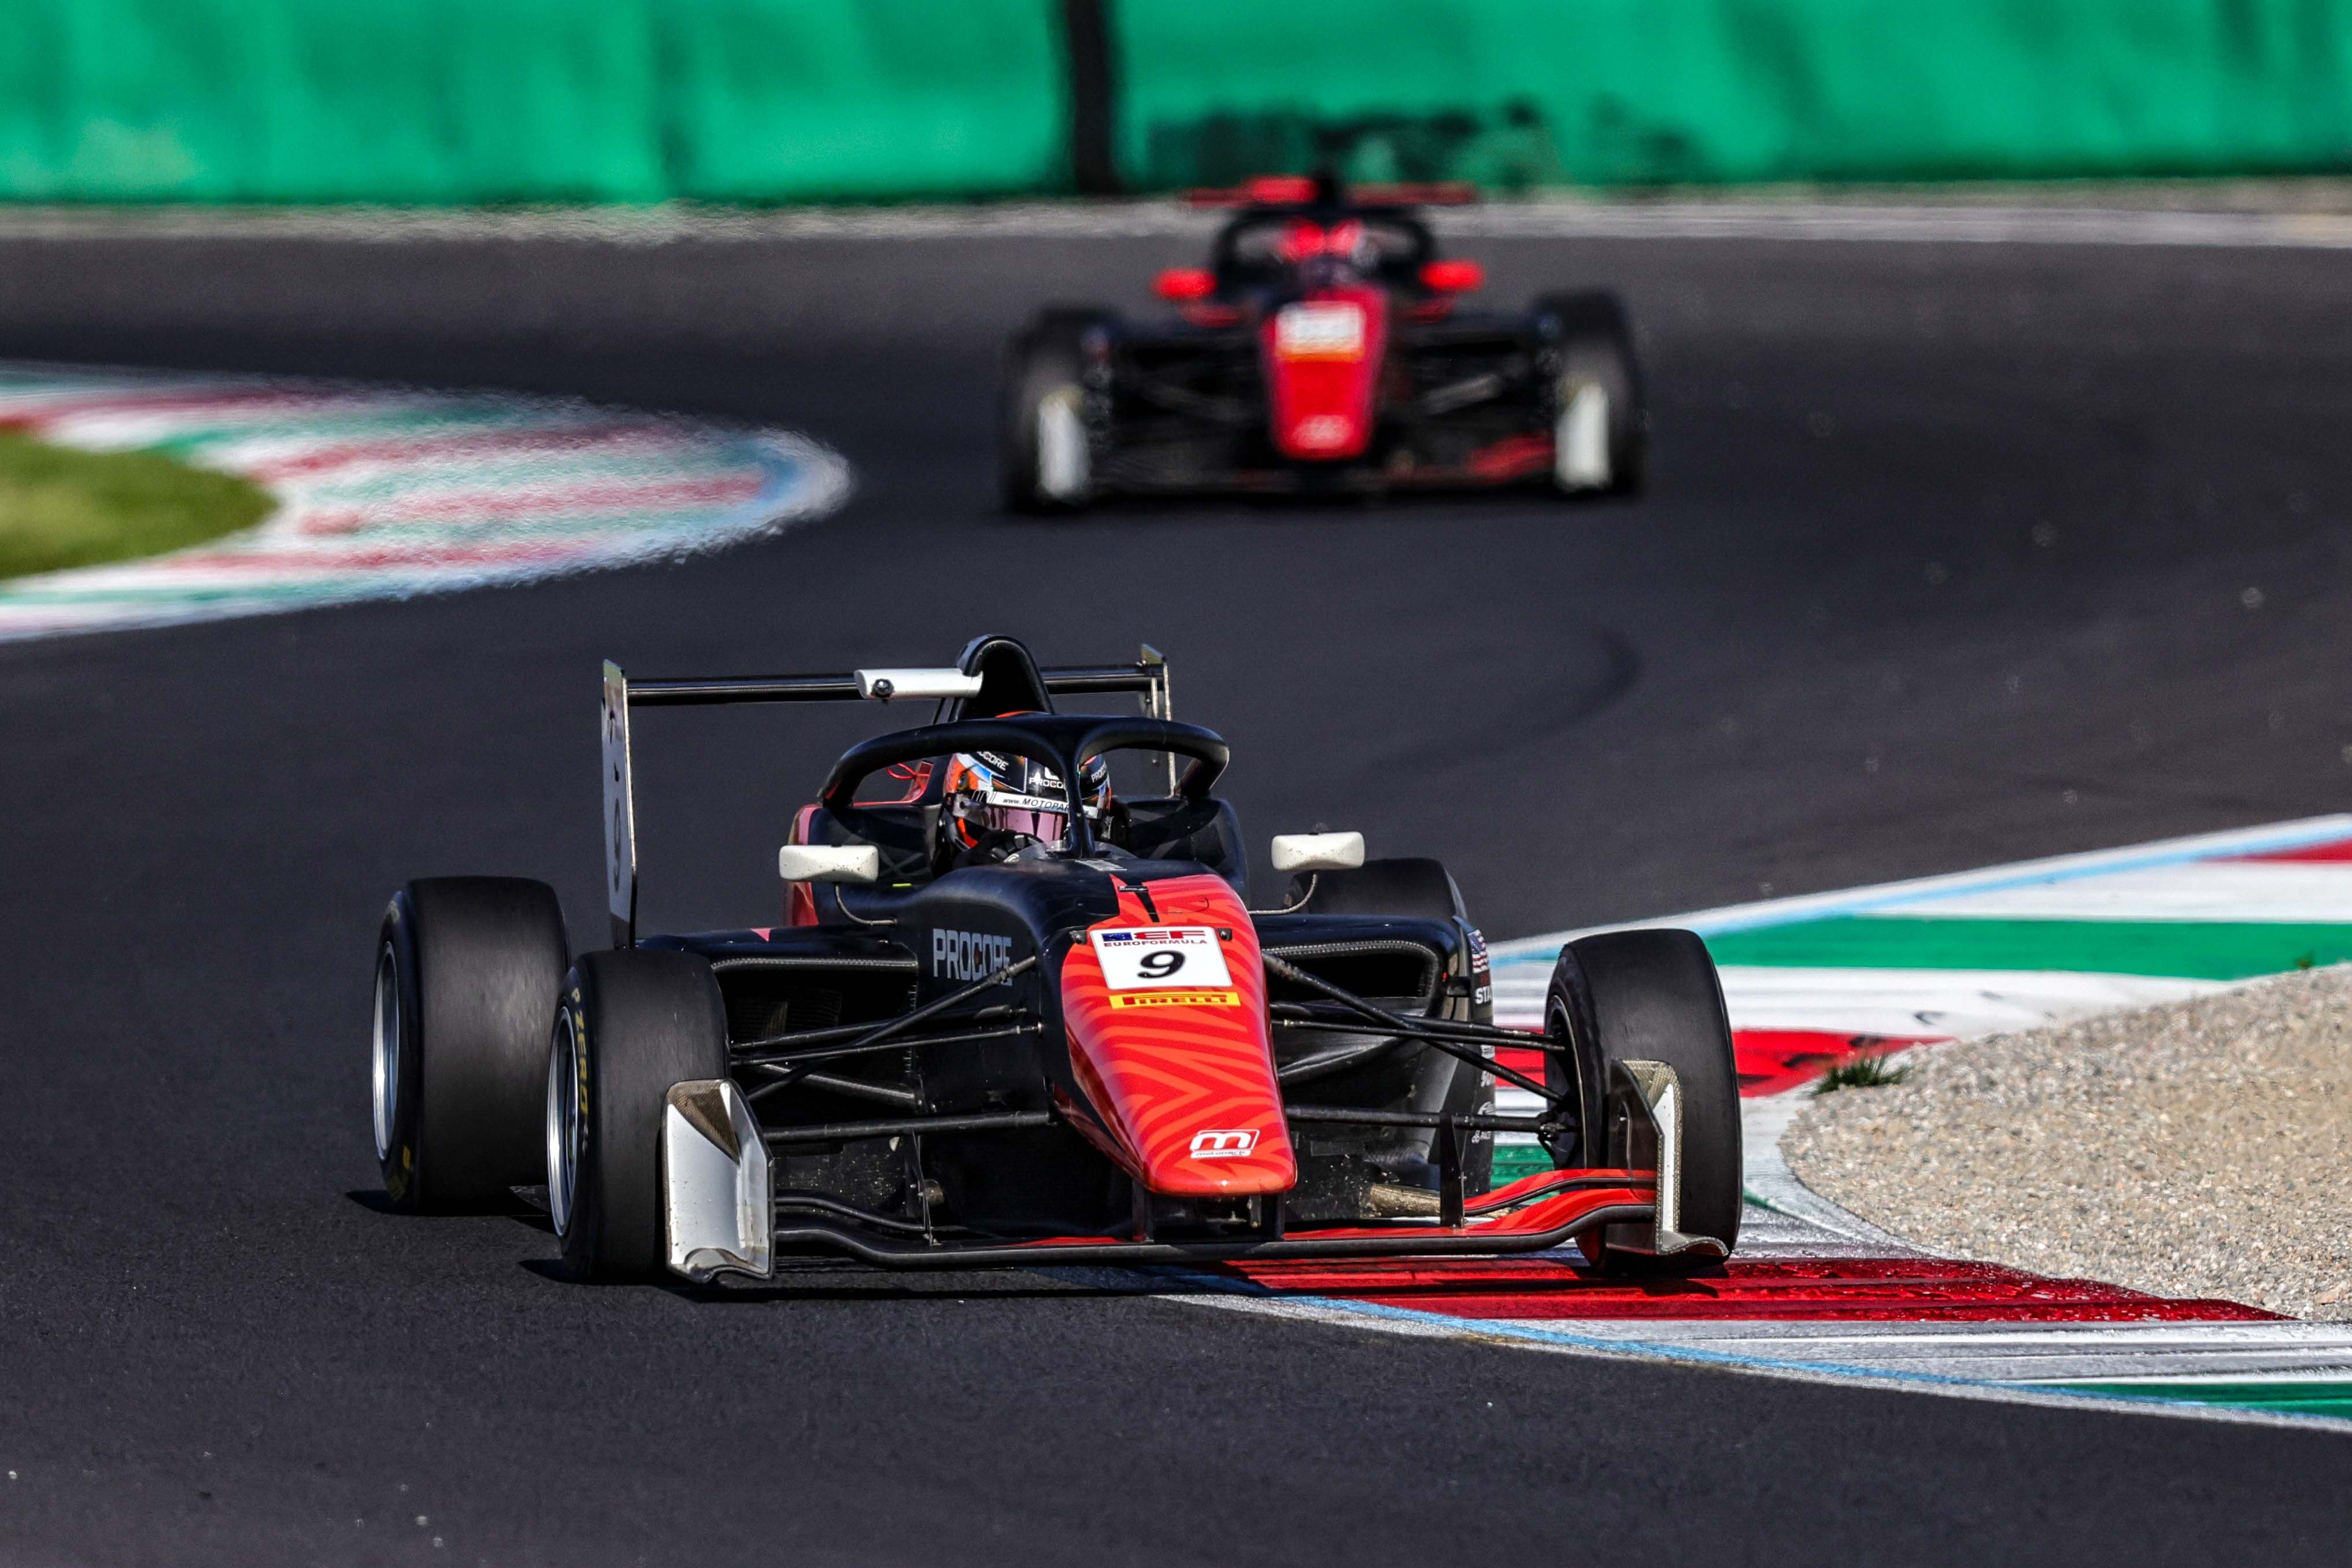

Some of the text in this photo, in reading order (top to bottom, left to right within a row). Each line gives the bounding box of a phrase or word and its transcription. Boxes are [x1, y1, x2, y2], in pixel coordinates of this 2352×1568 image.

[1028, 776, 1064, 789] PROCO
[1003, 798, 1069, 812] www.MOTOPAR
[1104, 939, 1207, 947] EUROFORMULA
[1137, 949, 1186, 979] 9
[1122, 994, 1227, 1005] PIRELLI
[575, 1009, 589, 1115] ZERO
